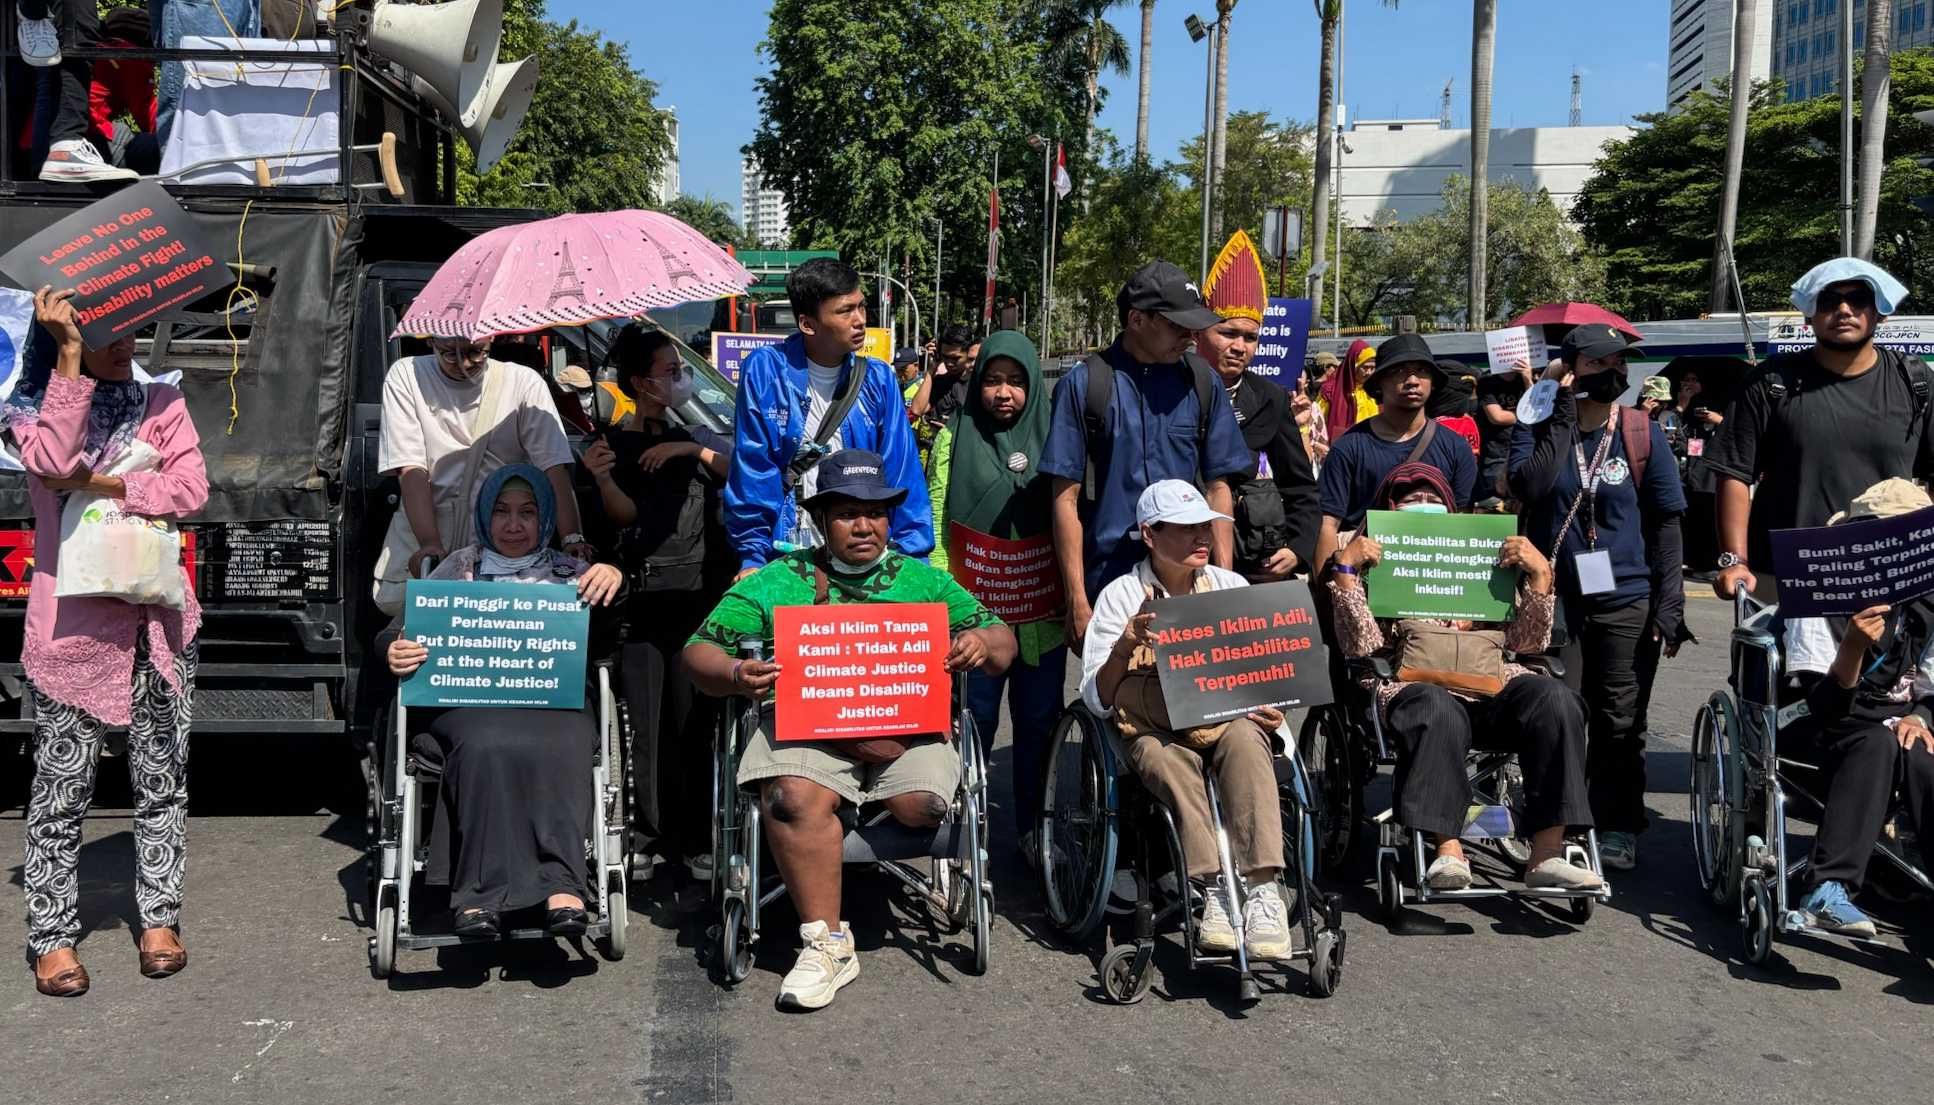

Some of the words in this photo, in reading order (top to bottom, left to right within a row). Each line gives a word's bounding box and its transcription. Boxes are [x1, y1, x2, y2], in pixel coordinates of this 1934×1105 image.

[39, 234, 94, 266] Leave
[91, 221, 120, 239] No
[119, 206, 153, 227] One
[60, 243, 122, 279] Behind
[119, 235, 141, 253] in
[137, 223, 168, 244] the
[76, 262, 141, 297] Climate
[138, 239, 187, 269] Fight!
[78, 283, 154, 327] Disability
[154, 254, 215, 290] matters
[1280, 324, 1291, 336] is
[842, 466, 879, 475] GREENPEACE
[1375, 534, 1399, 545] Hak
[1402, 535, 1466, 548] Disabilitas
[1469, 538, 1504, 549] Buka
[1798, 545, 1846, 558] Bumi
[1851, 536, 1904, 554] Sakit,
[965, 543, 987, 558] Hak
[989, 543, 1052, 561] Disabilitas
[1383, 551, 1432, 562] Sekedar
[1435, 553, 1501, 566] Pelengkap
[964, 558, 1001, 575] Bukan
[1004, 558, 1052, 575] Sekedar
[1392, 567, 1419, 578] Aksi
[1422, 567, 1452, 579] Iklim
[1455, 570, 1492, 580] mesti
[1807, 559, 1866, 573] Paling
[975, 576, 1040, 590] Pelengkap
[1782, 579, 1817, 588] The
[1823, 572, 1882, 587] Planet
[1812, 591, 1856, 601] Bear
[1860, 586, 1890, 599] the
[1894, 571, 1934, 591] Brun
[988, 592, 1020, 601] Iklim
[1023, 583, 1055, 600] mesti
[1415, 583, 1464, 595] Inklusif!
[415, 595, 449, 609] Dari
[453, 596, 510, 612] Pinggir
[513, 598, 533, 611] ke
[537, 599, 583, 612] Pusat
[451, 616, 545, 631] Perlawanan
[799, 622, 836, 636] Aksi
[840, 621, 879, 635] Iklim
[883, 620, 929, 635] Tanpa
[1156, 625, 1215, 646] Akses
[1219, 616, 1268, 636] Iklim
[1272, 607, 1313, 628] Adil,
[416, 634, 444, 647] Put
[448, 635, 522, 652] Disability
[526, 637, 577, 653] Rights
[798, 644, 841, 657] Kami
[845, 645, 851, 655] :
[854, 642, 898, 655] Tidak
[902, 640, 930, 653] Adil
[1168, 652, 1207, 671] Hak
[1211, 636, 1312, 664] Disabilitas
[437, 655, 454, 667] at
[458, 655, 484, 668] the
[488, 656, 534, 670] Heart
[538, 657, 555, 670] of
[804, 664, 867, 678] Climate
[871, 661, 927, 675] Justice
[430, 674, 492, 688] Climate
[495, 675, 560, 689] Justice!
[1194, 662, 1296, 693] Terpenuhi!
[801, 685, 855, 699] Means
[859, 682, 930, 697] Disability
[836, 704, 900, 720] Justice!
